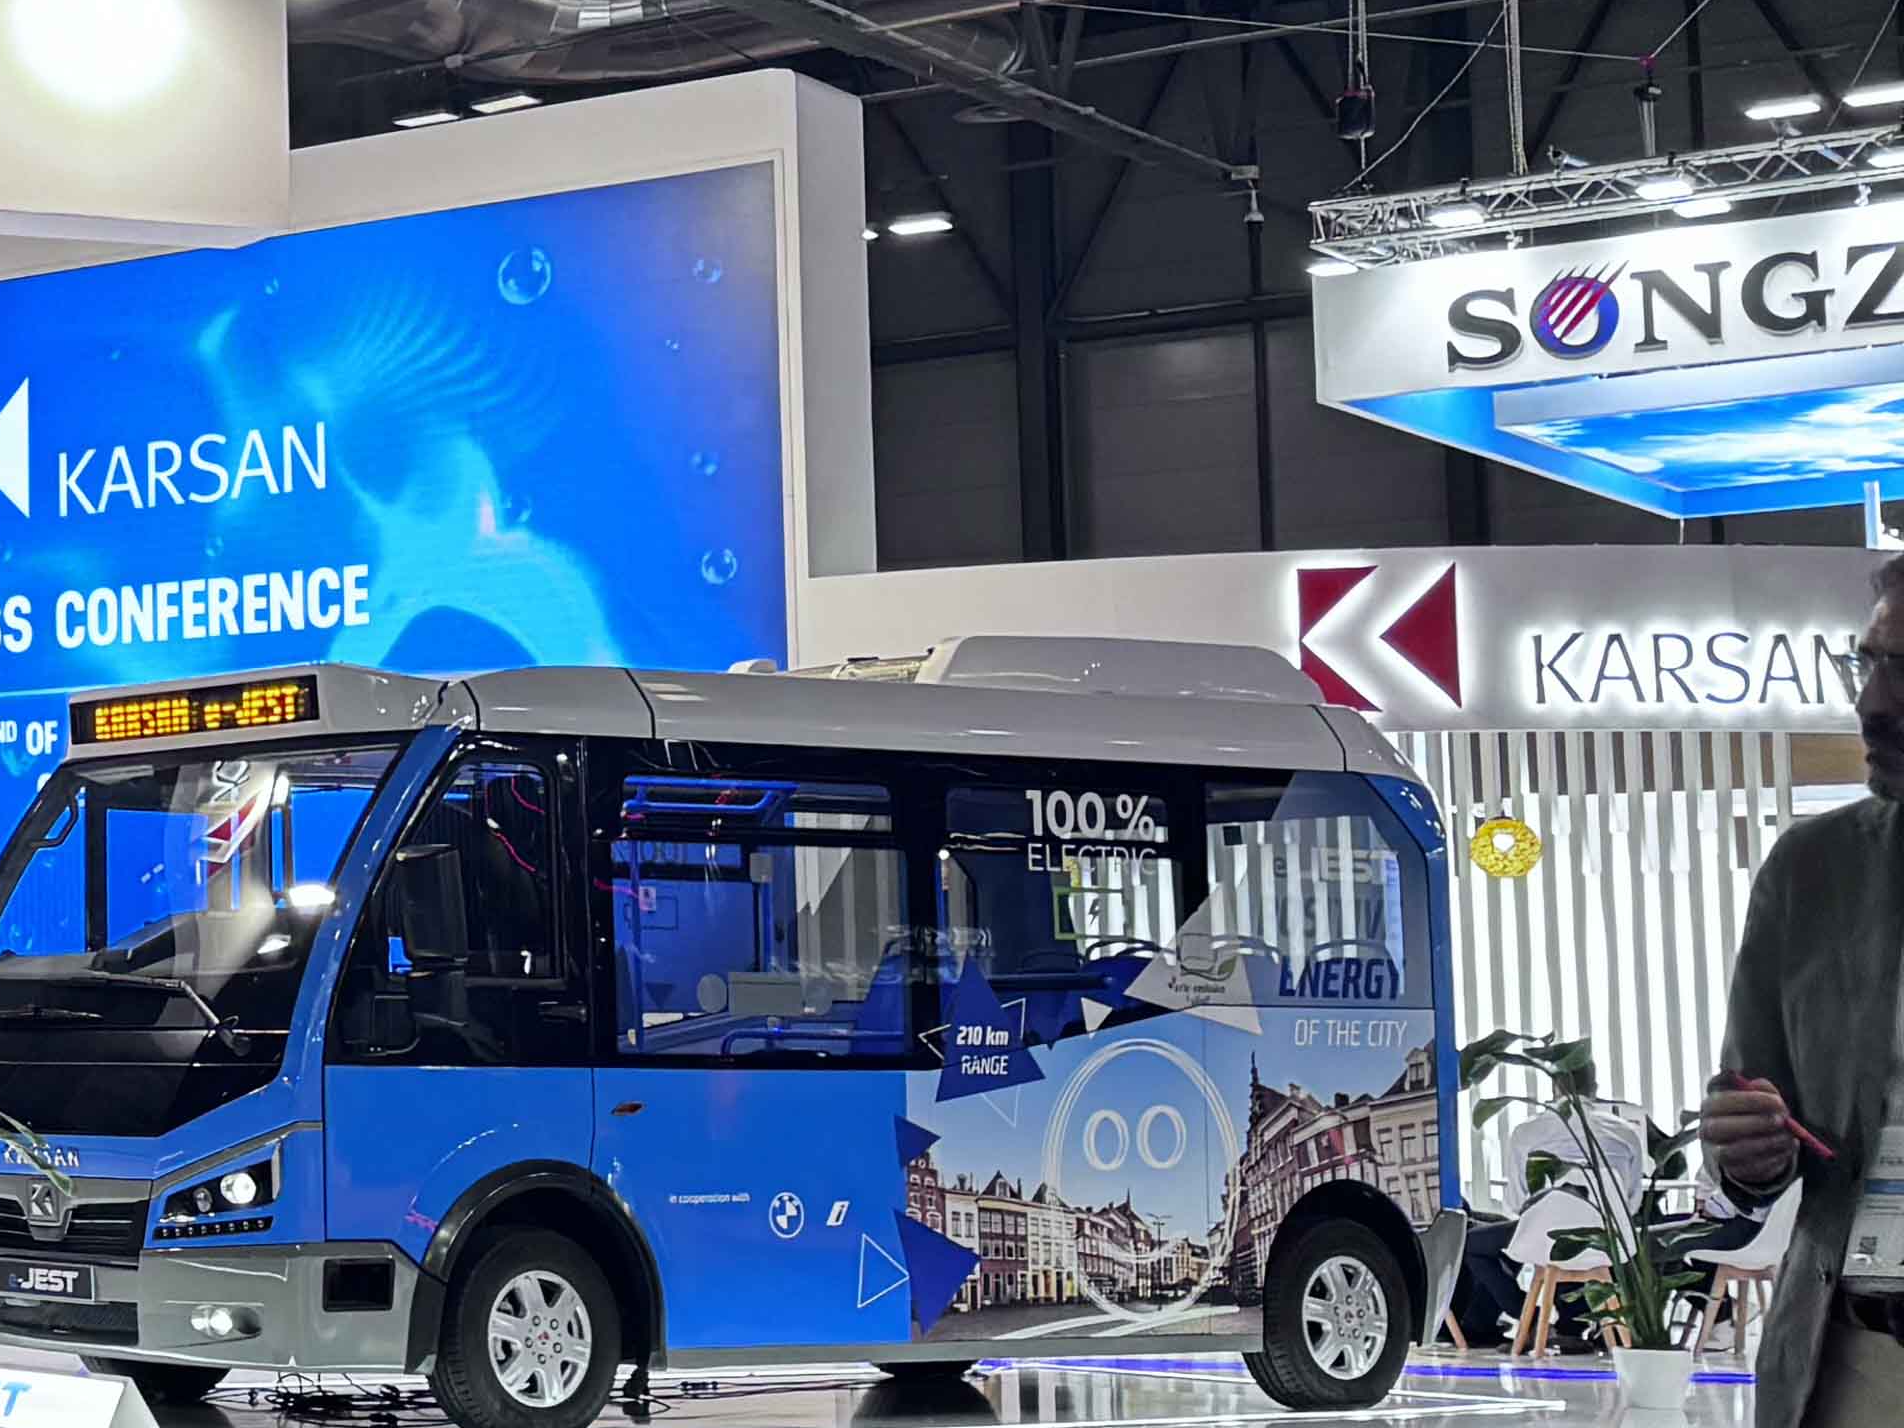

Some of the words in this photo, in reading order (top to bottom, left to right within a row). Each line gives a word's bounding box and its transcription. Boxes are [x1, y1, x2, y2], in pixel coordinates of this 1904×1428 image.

[58, 421, 328, 519] KARSAN
[56, 564, 369, 650] CONFERENCE
[1532, 632, 1858, 705] KARSAN
[25, 720, 59, 756] OF
[1026, 789, 1106, 838] 100
[1027, 843, 1158, 874] ELECTRIC
[1279, 956, 1406, 1000] ENERGY
[957, 1026, 983, 1046] 210
[986, 1026, 1009, 1046] km
[1295, 1020, 1320, 1047] OF
[1327, 1020, 1361, 1047] THE
[1368, 1020, 1407, 1047] CITY
[962, 1055, 1009, 1076] RANGE
